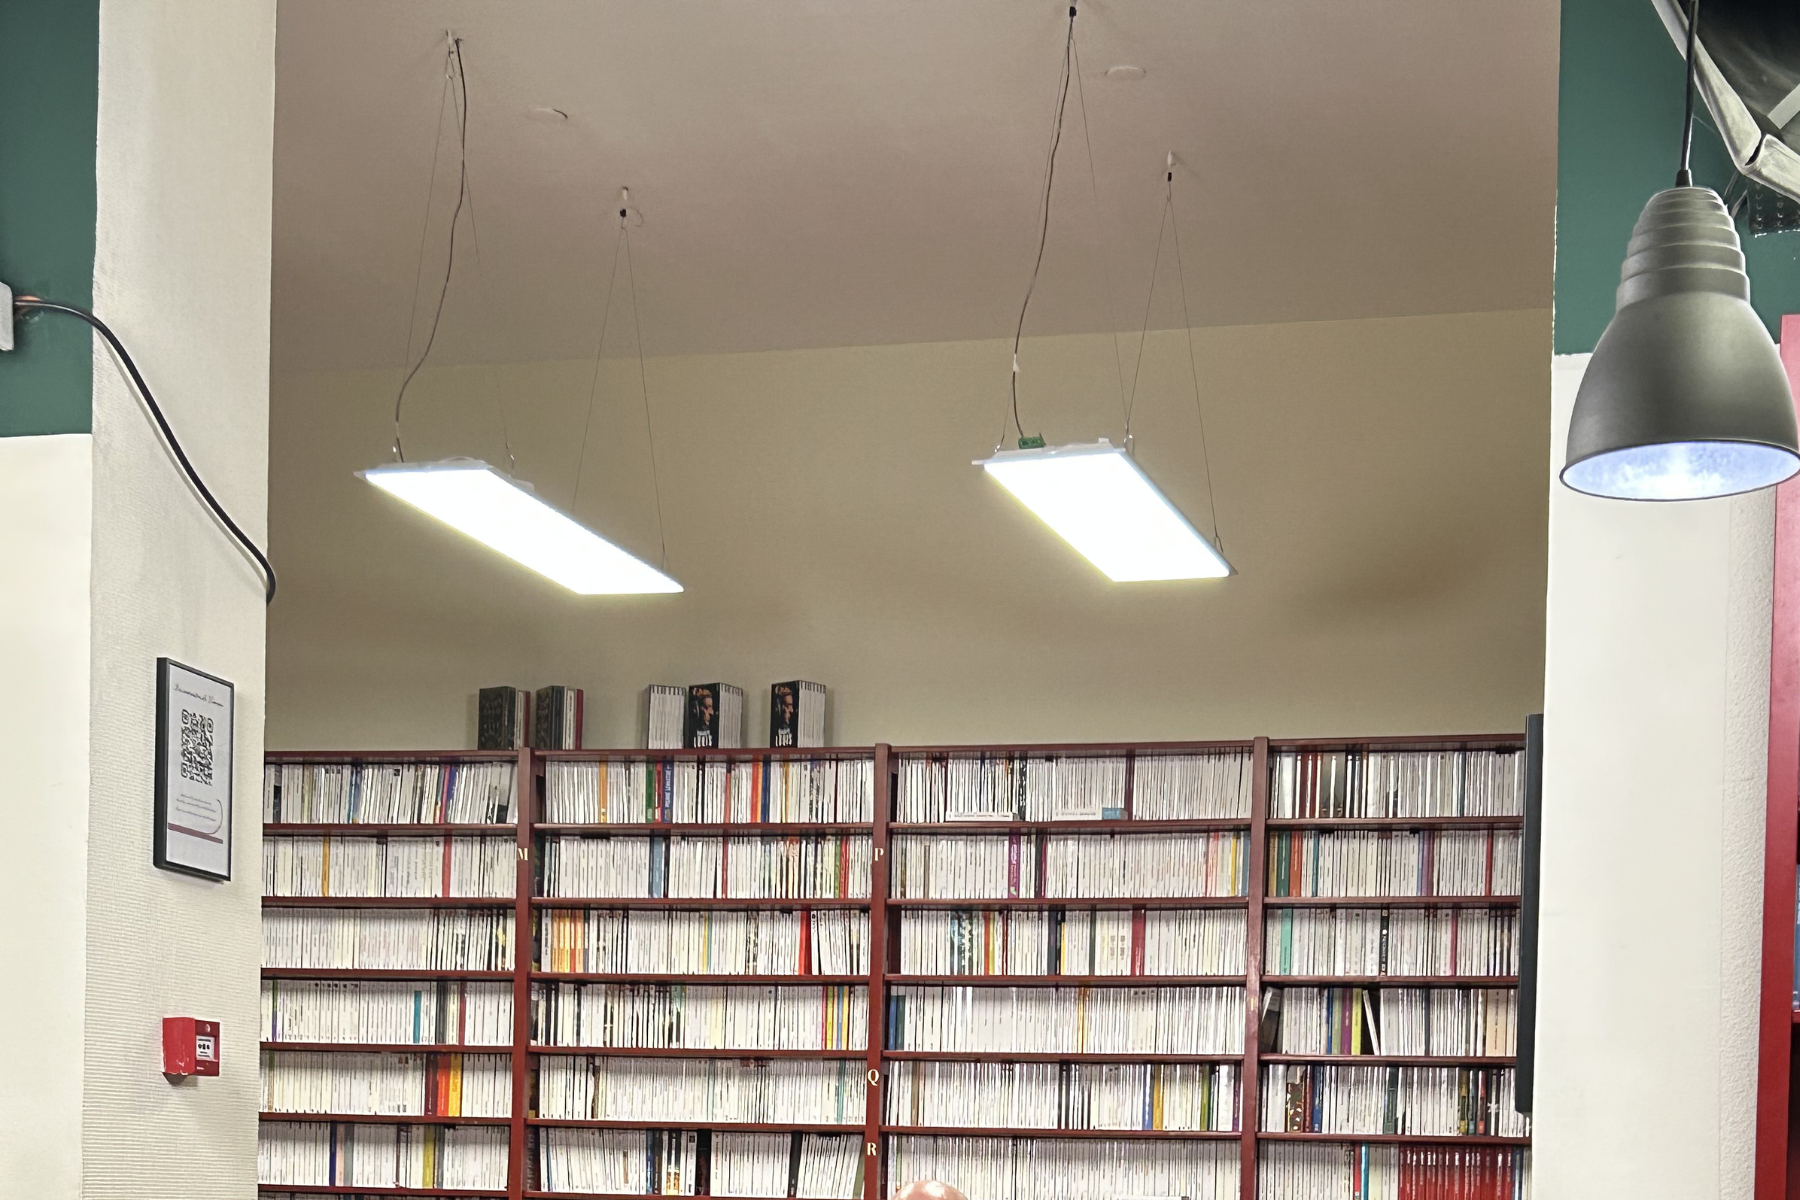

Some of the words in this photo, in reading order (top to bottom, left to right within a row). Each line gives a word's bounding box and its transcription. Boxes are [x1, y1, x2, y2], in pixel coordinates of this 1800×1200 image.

[517, 847, 528, 861] M
[874, 847, 884, 861] P
[867, 1069, 879, 1086] Q
[866, 1142, 877, 1156] R
